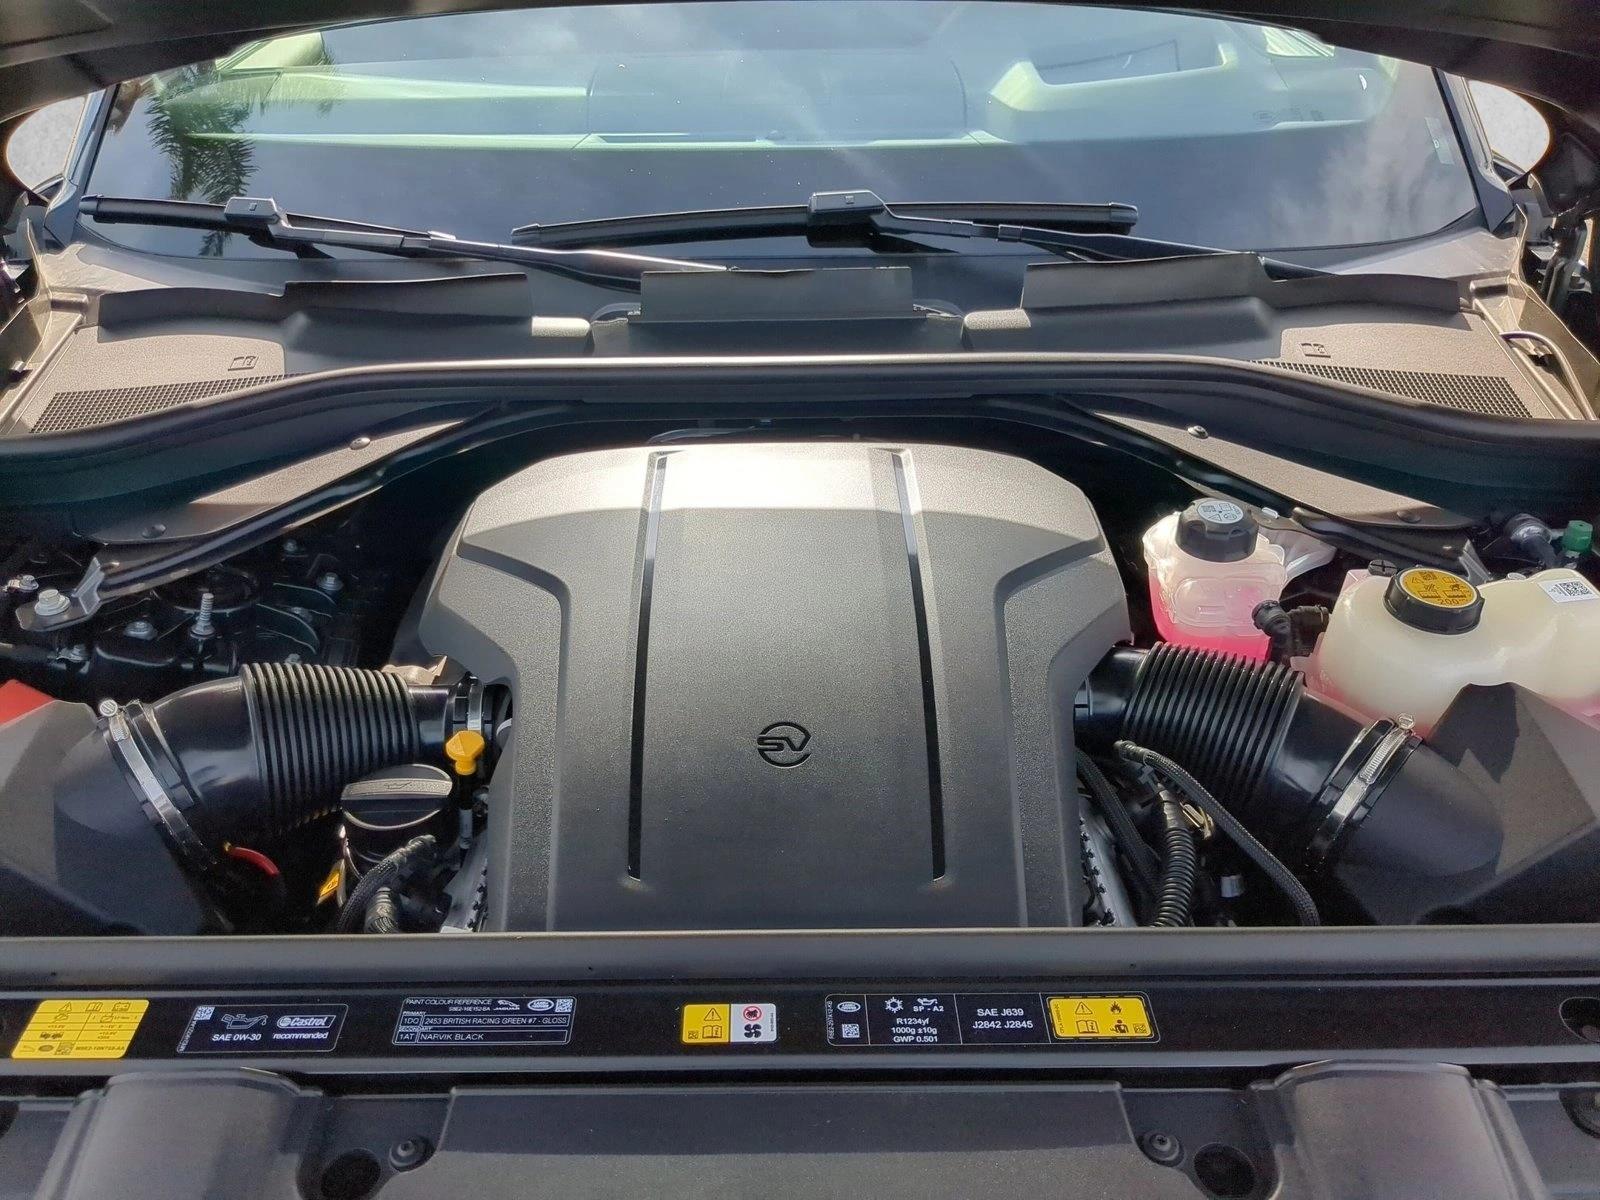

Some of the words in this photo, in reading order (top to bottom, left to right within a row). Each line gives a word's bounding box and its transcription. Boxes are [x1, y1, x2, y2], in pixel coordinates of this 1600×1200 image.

[977, 1008, 998, 1017] SAE
[1001, 1008, 1024, 1017] J639
[291, 1016, 328, 1027] Castrol
[424, 1017, 442, 1025] 2453
[443, 1017, 470, 1025] BRITISH
[472, 1017, 500, 1025] RACING
[542, 1016, 567, 1024] GLOSS
[896, 1018, 930, 1026] R1234yf
[972, 1020, 1002, 1029] J2842
[1004, 1020, 1033, 1029] J2845
[273, 1031, 329, 1039] recommended
[891, 1027, 916, 1035] 1000g
[212, 1033, 232, 1041] SAE
[233, 1033, 262, 1041] 0W-30
